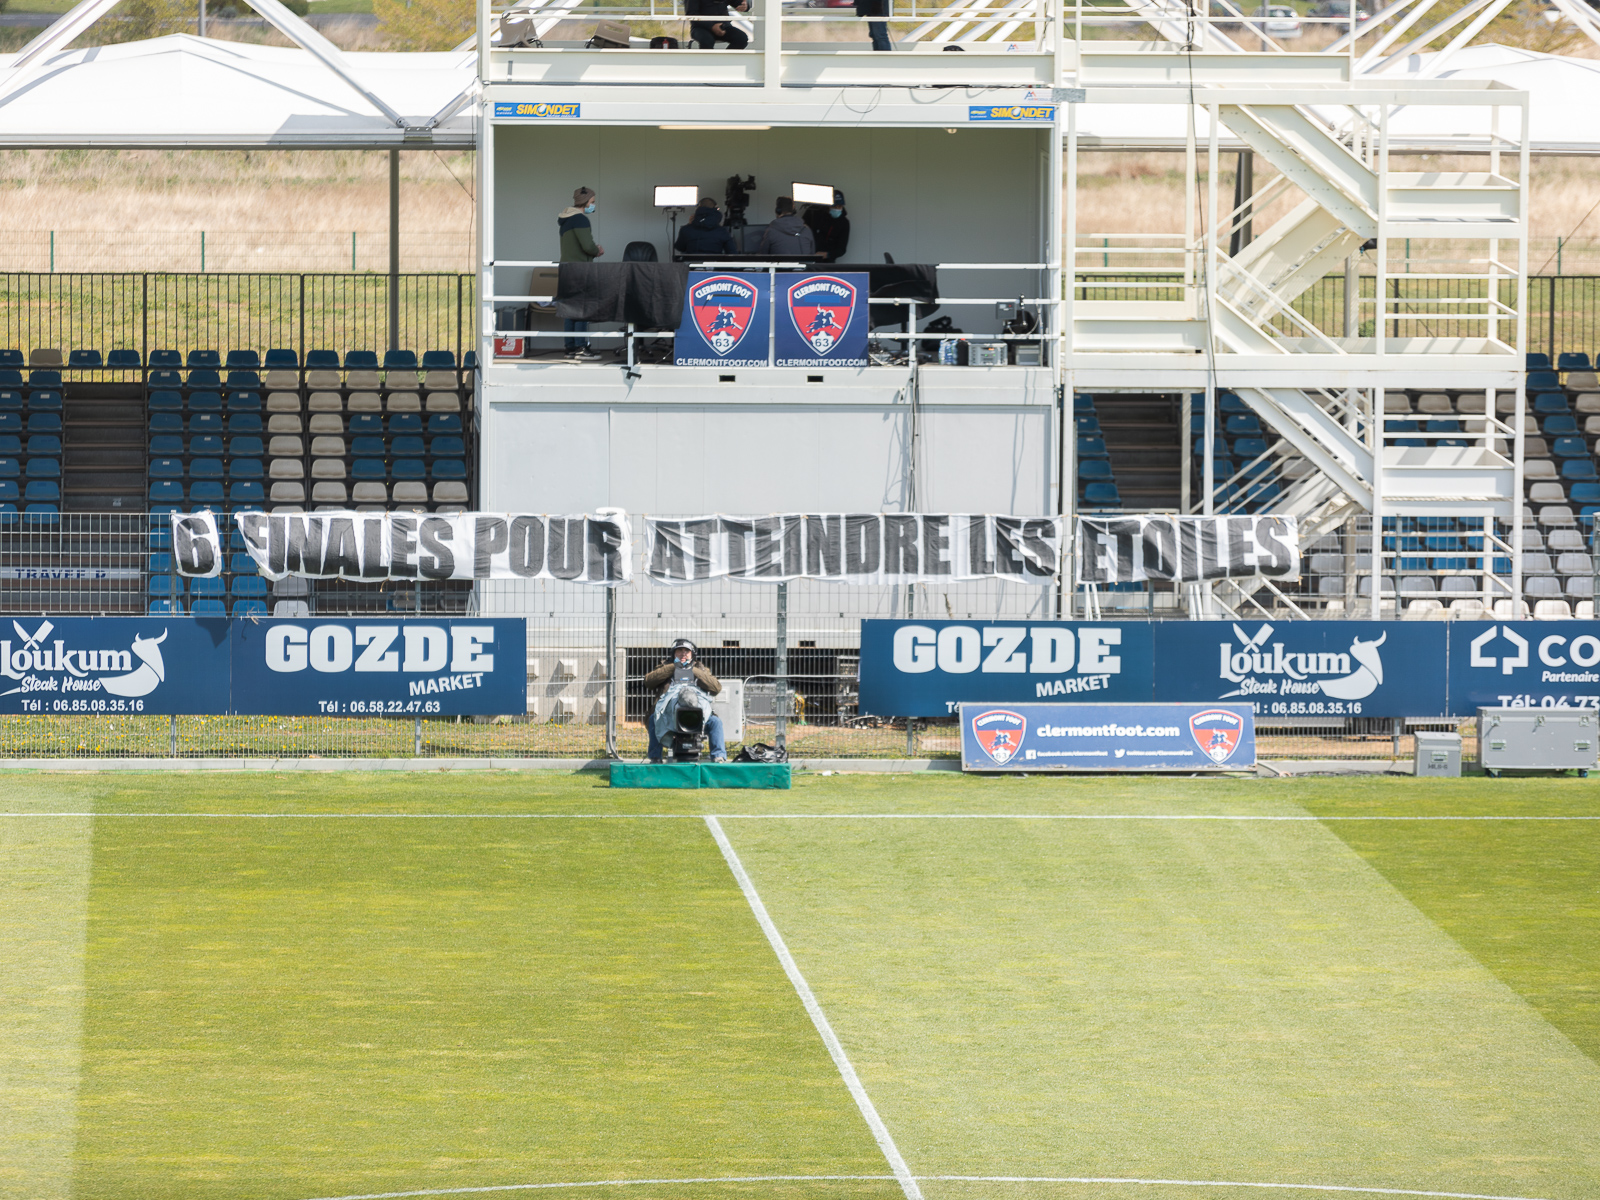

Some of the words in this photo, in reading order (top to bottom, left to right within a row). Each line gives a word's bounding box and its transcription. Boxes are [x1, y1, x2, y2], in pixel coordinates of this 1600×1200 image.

[516, 103, 579, 117] SIMONDET
[990, 106, 1054, 119] SIMONDET
[695, 283, 732, 299] CLERMONT
[731, 283, 752, 299] FOOT
[793, 283, 831, 299] CLERMONT
[830, 284, 850, 299] FOOT
[715, 338, 730, 348] 63
[815, 338, 830, 347] 63
[676, 358, 768, 367] CLERMONTFOOT.COM
[776, 358, 867, 367] CLERMONTFOOT.COM
[175, 518, 216, 574] 6
[242, 515, 454, 579] FINALES
[473, 515, 622, 581] POUR
[650, 514, 951, 580] ATTEINDRE
[969, 515, 1056, 577] LES
[1081, 517, 1292, 582] ETOILES
[265, 624, 494, 673] GOZDE
[892, 625, 1122, 674] GOZDE
[1538, 635, 1600, 667] CO
[0, 640, 132, 680] Loukum
[1219, 642, 1351, 683] Loukum
[21, 674, 58, 693] Steak
[61, 676, 101, 693] House
[1541, 670, 1600, 682] Partenaire
[409, 672, 484, 697] MARKET
[1035, 674, 1111, 698] MARKET
[1240, 676, 1277, 696] Steak
[1280, 679, 1320, 696] House
[21, 699, 41, 711] Tél
[53, 699, 144, 712] 06.85.08.35.16
[318, 700, 339, 713] Tél
[350, 701, 441, 713] 06.58.22.47.63
[945, 701, 960, 714] Té
[1271, 701, 1362, 714] 06.85.08.35.16
[1036, 724, 1180, 738] clermontfoot.com
